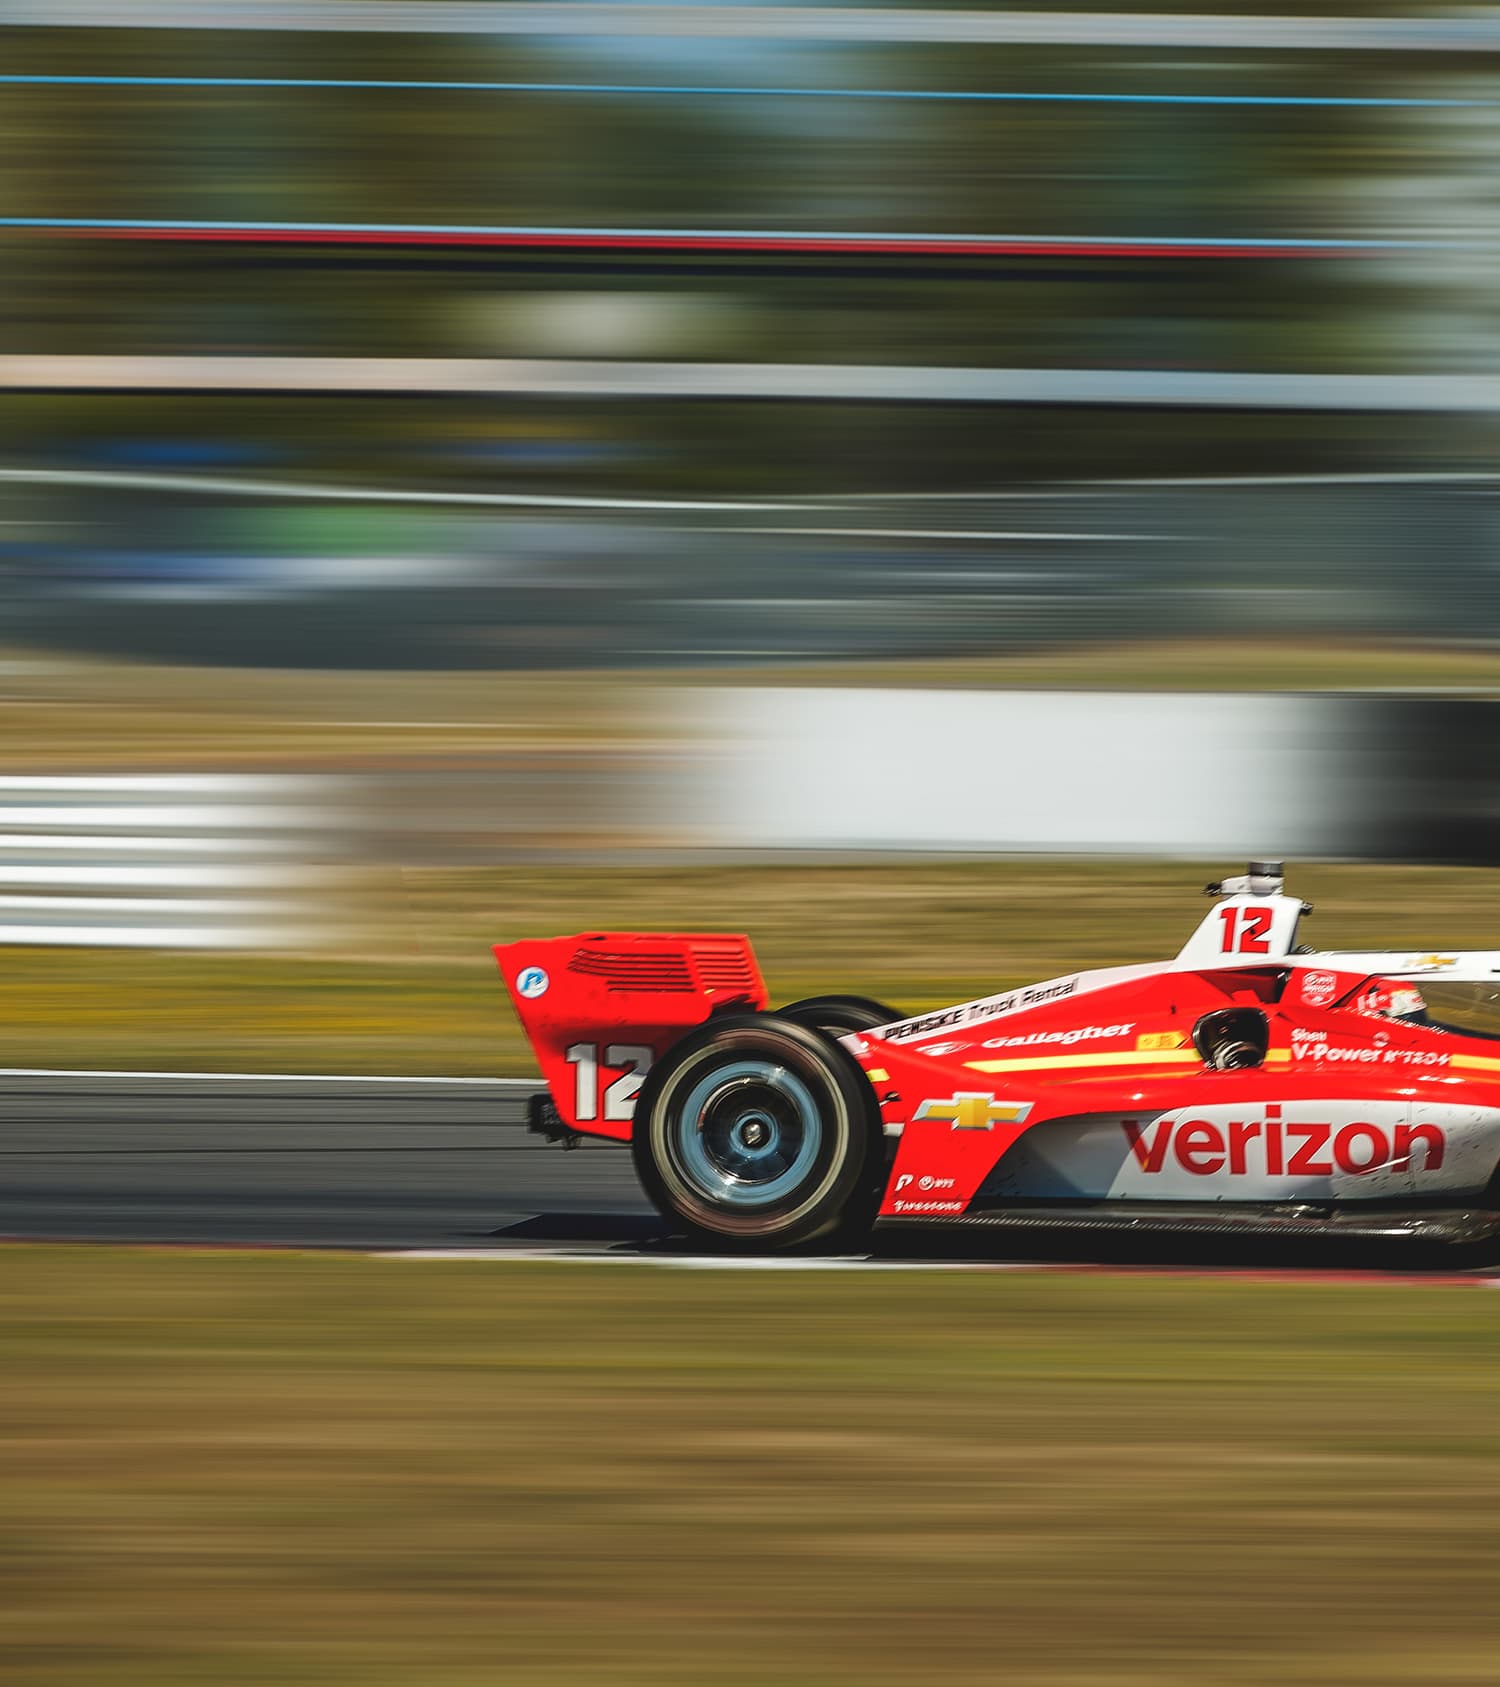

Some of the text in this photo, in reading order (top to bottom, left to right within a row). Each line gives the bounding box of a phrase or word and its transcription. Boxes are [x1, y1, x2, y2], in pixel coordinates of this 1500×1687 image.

[1219, 906, 1273, 954] 12
[884, 977, 1079, 1040] PENSKE Truck Rental
[981, 1022, 1137, 1049] Gallagher
[1291, 1043, 1383, 1063] V-Power
[565, 1043, 654, 1121] 12
[1120, 1104, 1446, 1176] verizon
